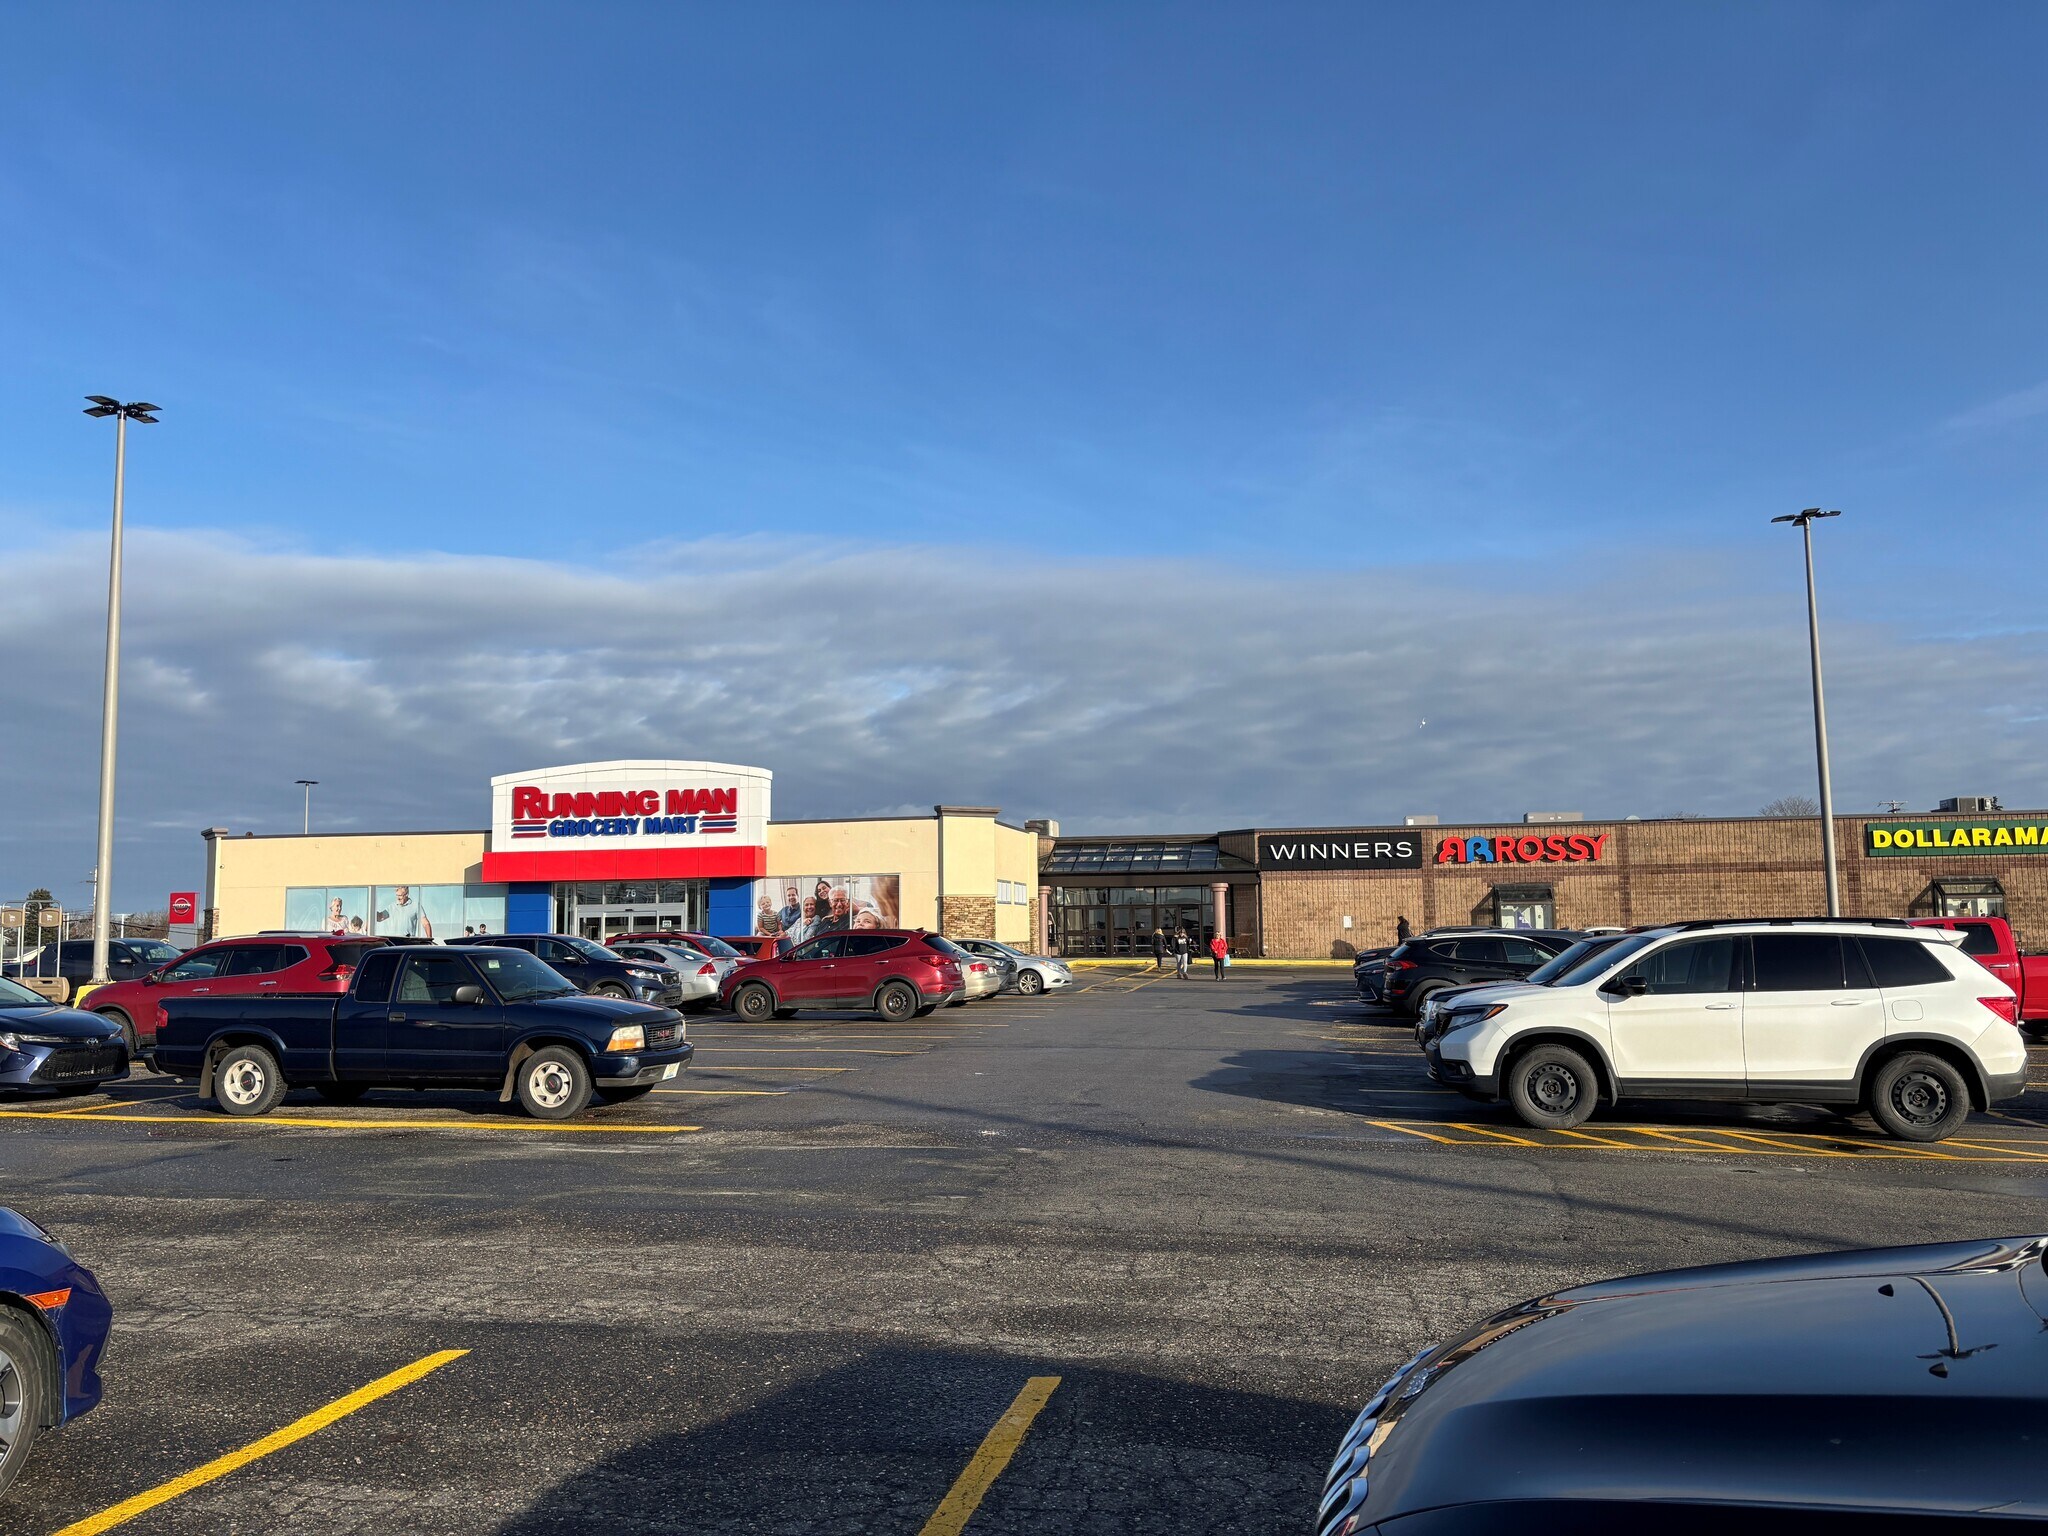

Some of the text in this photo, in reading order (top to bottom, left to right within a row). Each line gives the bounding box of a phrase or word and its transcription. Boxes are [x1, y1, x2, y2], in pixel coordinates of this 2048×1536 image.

[512, 787, 737, 819] RUNNING MAN
[548, 816, 700, 838] GROCERY MART
[1270, 841, 1413, 860] WINNERS
[625, 889, 637, 898] 76
